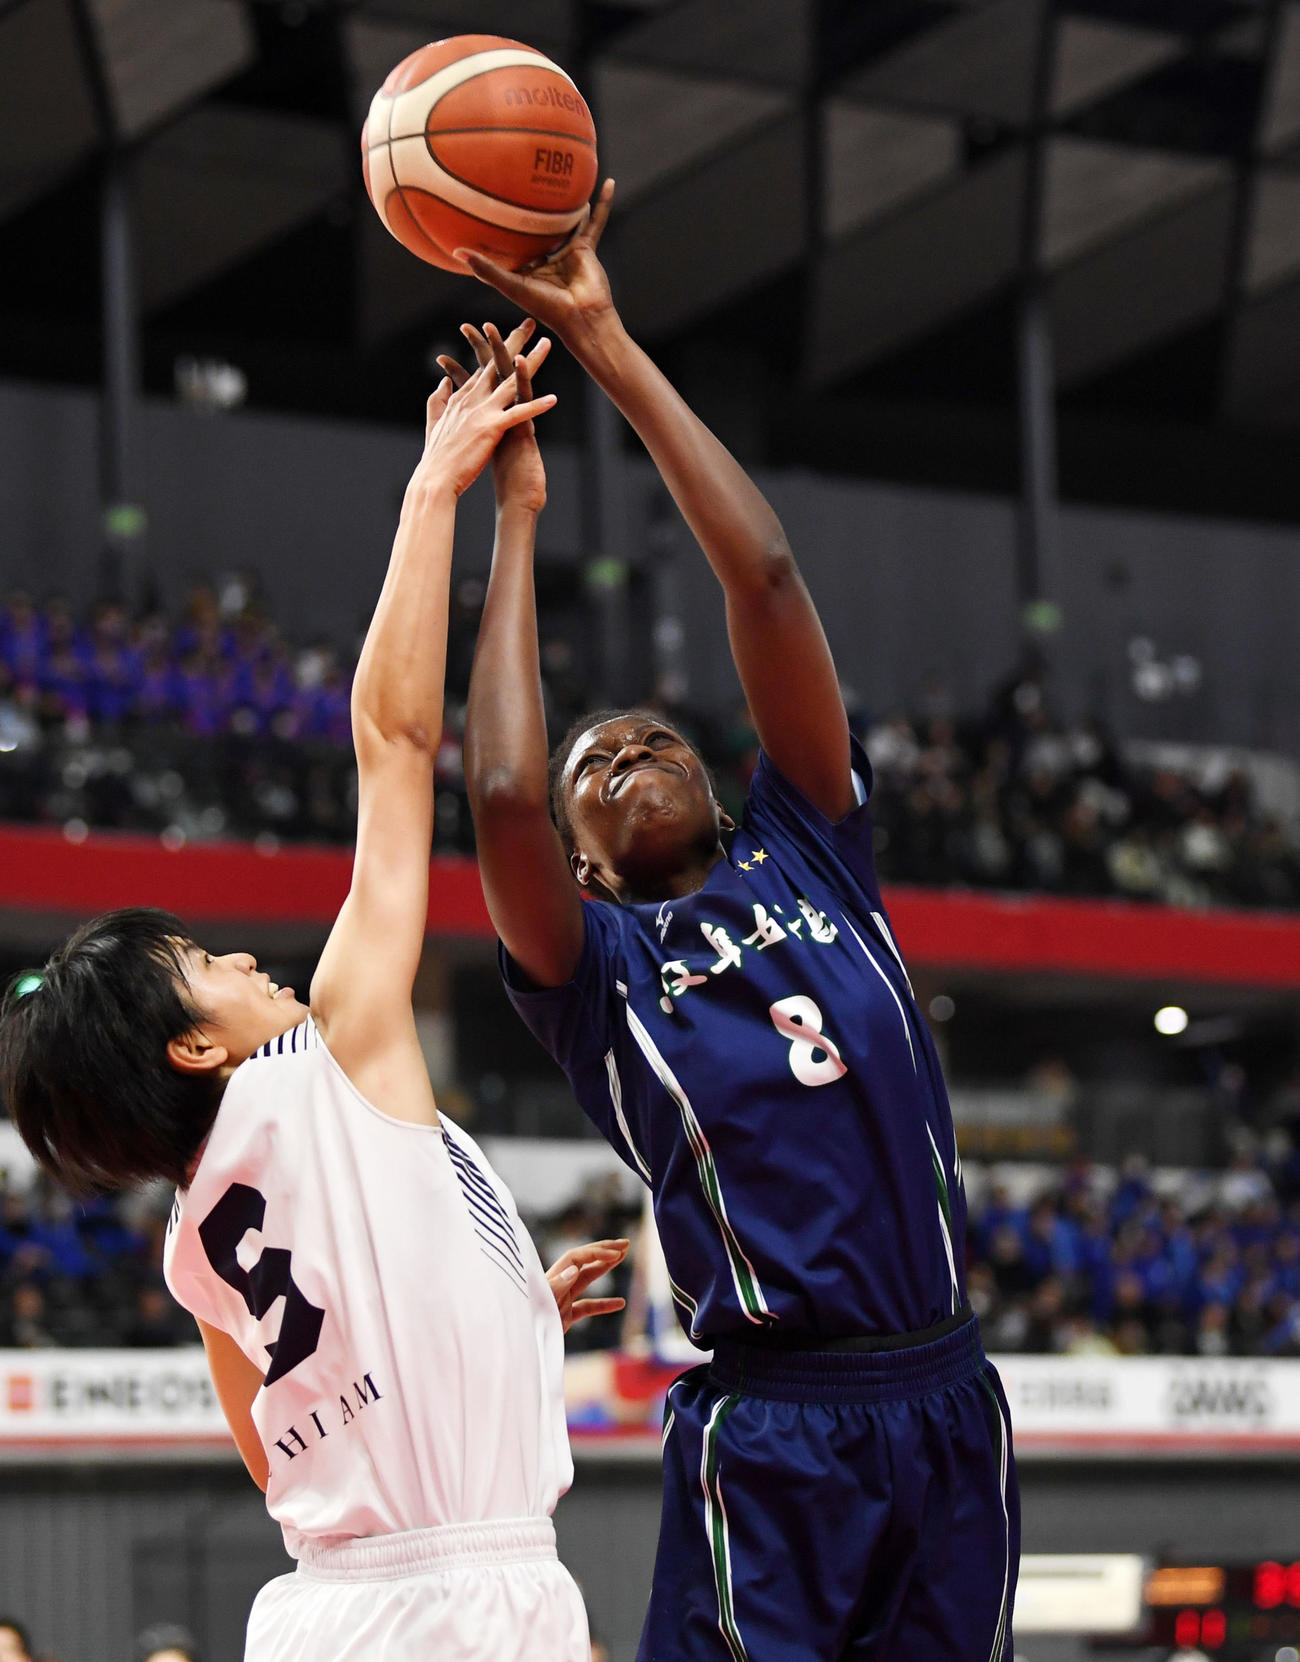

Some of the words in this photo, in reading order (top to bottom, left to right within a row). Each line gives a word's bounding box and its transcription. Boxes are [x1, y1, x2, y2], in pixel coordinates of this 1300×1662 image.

[504, 86, 585, 117] molten
[533, 149, 574, 175] FIBA
[769, 995, 848, 1087] 8
